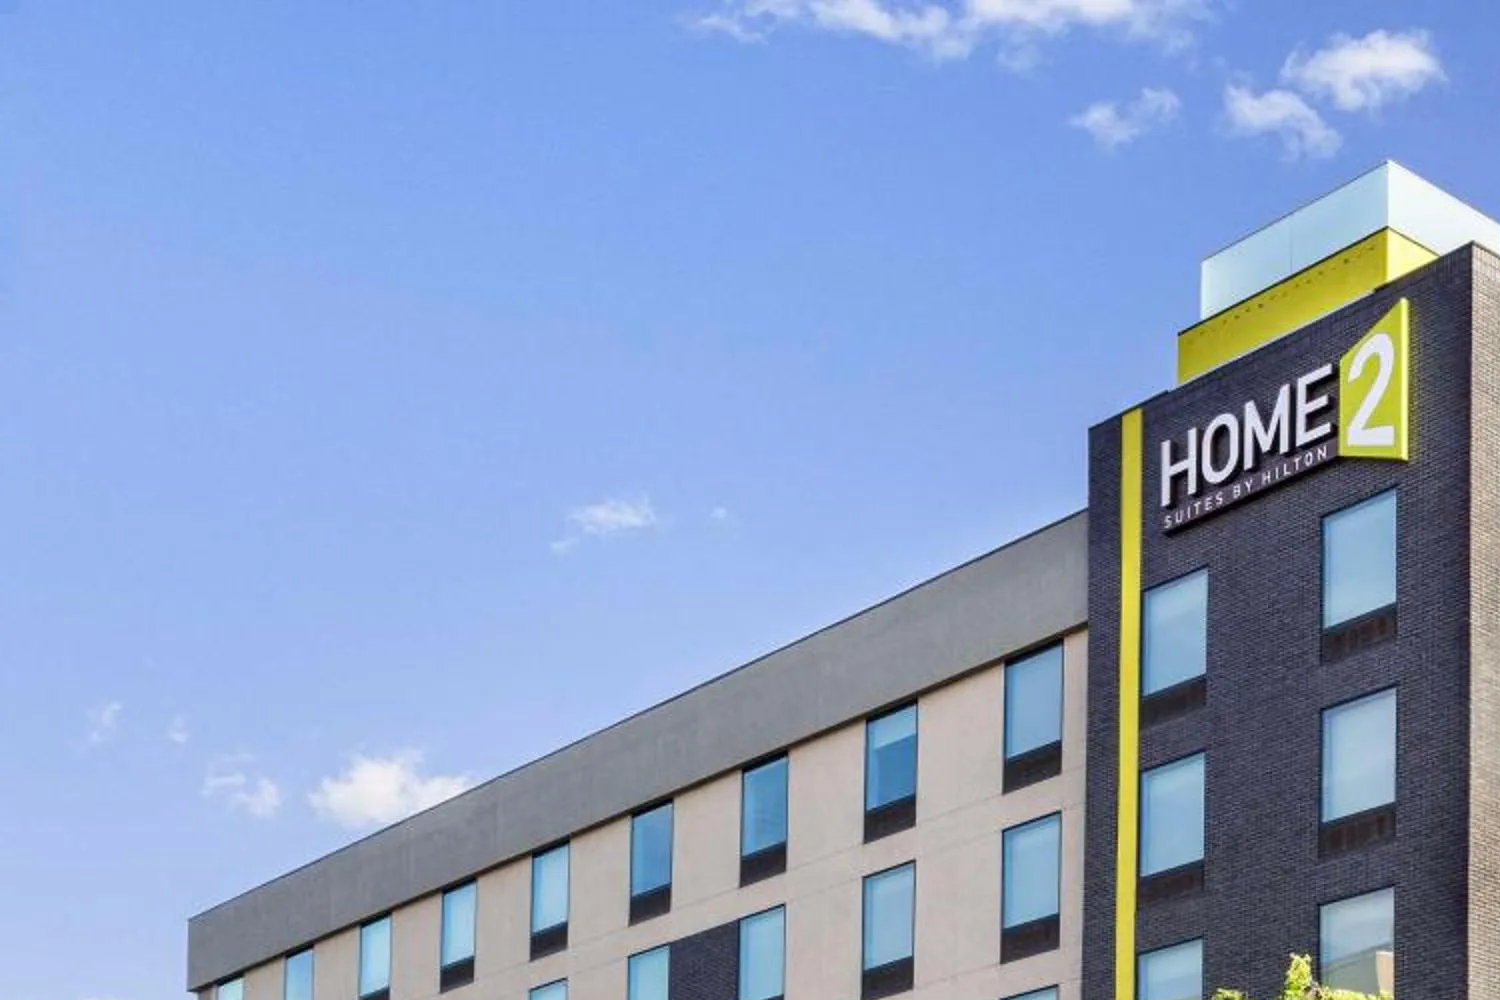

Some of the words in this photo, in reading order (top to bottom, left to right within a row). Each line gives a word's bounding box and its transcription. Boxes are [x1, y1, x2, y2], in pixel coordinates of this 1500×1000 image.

[1160, 363, 1333, 508] HOME
[1346, 332, 1395, 447] 2
[1163, 494, 1224, 530] SUITES
[1232, 480, 1253, 499] BY
[1261, 445, 1328, 487] HILTON
